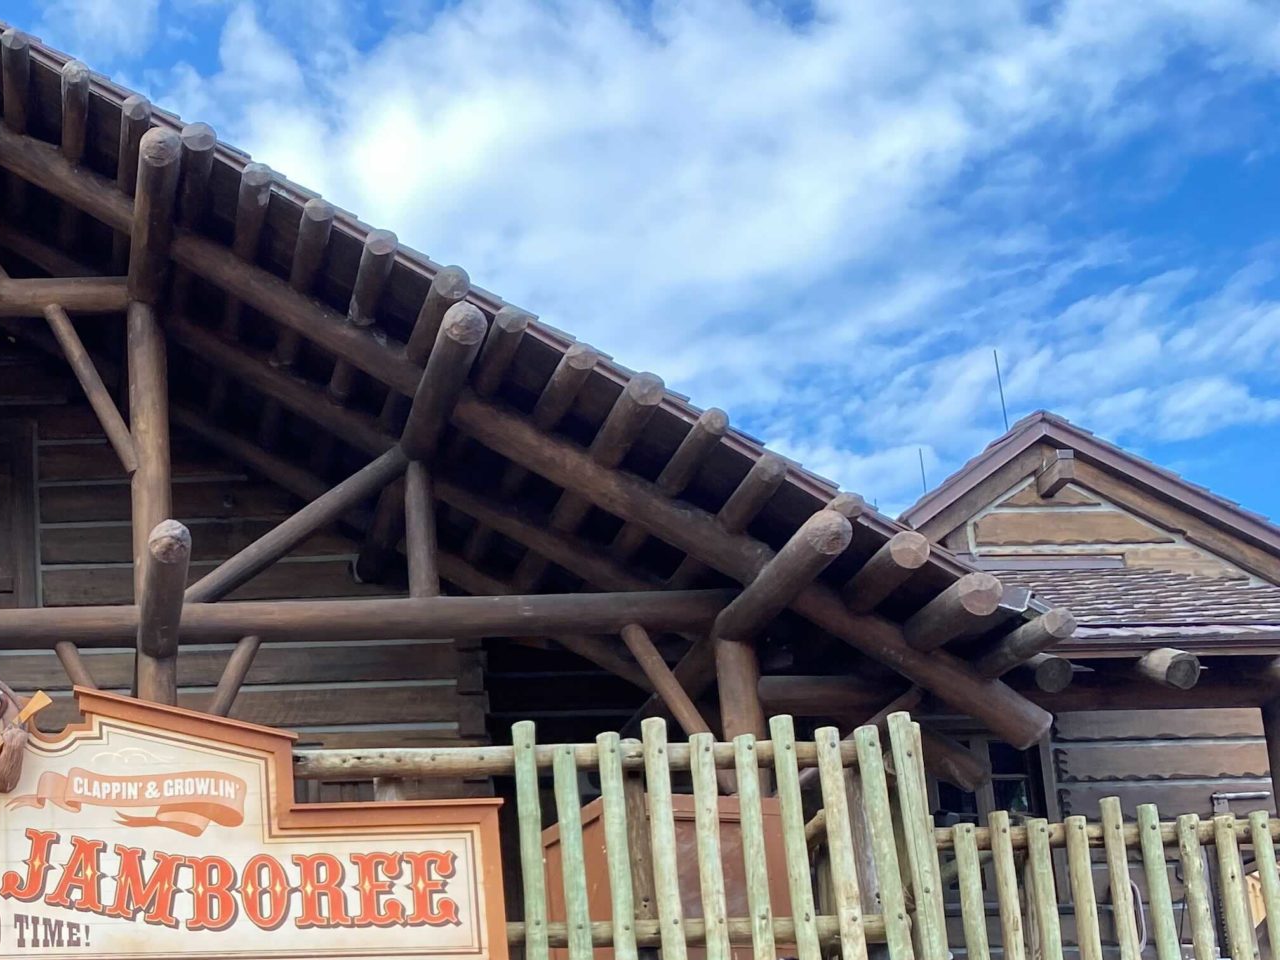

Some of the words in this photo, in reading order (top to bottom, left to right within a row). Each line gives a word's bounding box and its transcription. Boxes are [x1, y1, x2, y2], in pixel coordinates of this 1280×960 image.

[73, 776, 143, 800] CLAPPIN'
[144, 781, 161, 799] &
[163, 777, 240, 799] GROWLIN'
[14, 913, 92, 949] TIME!
